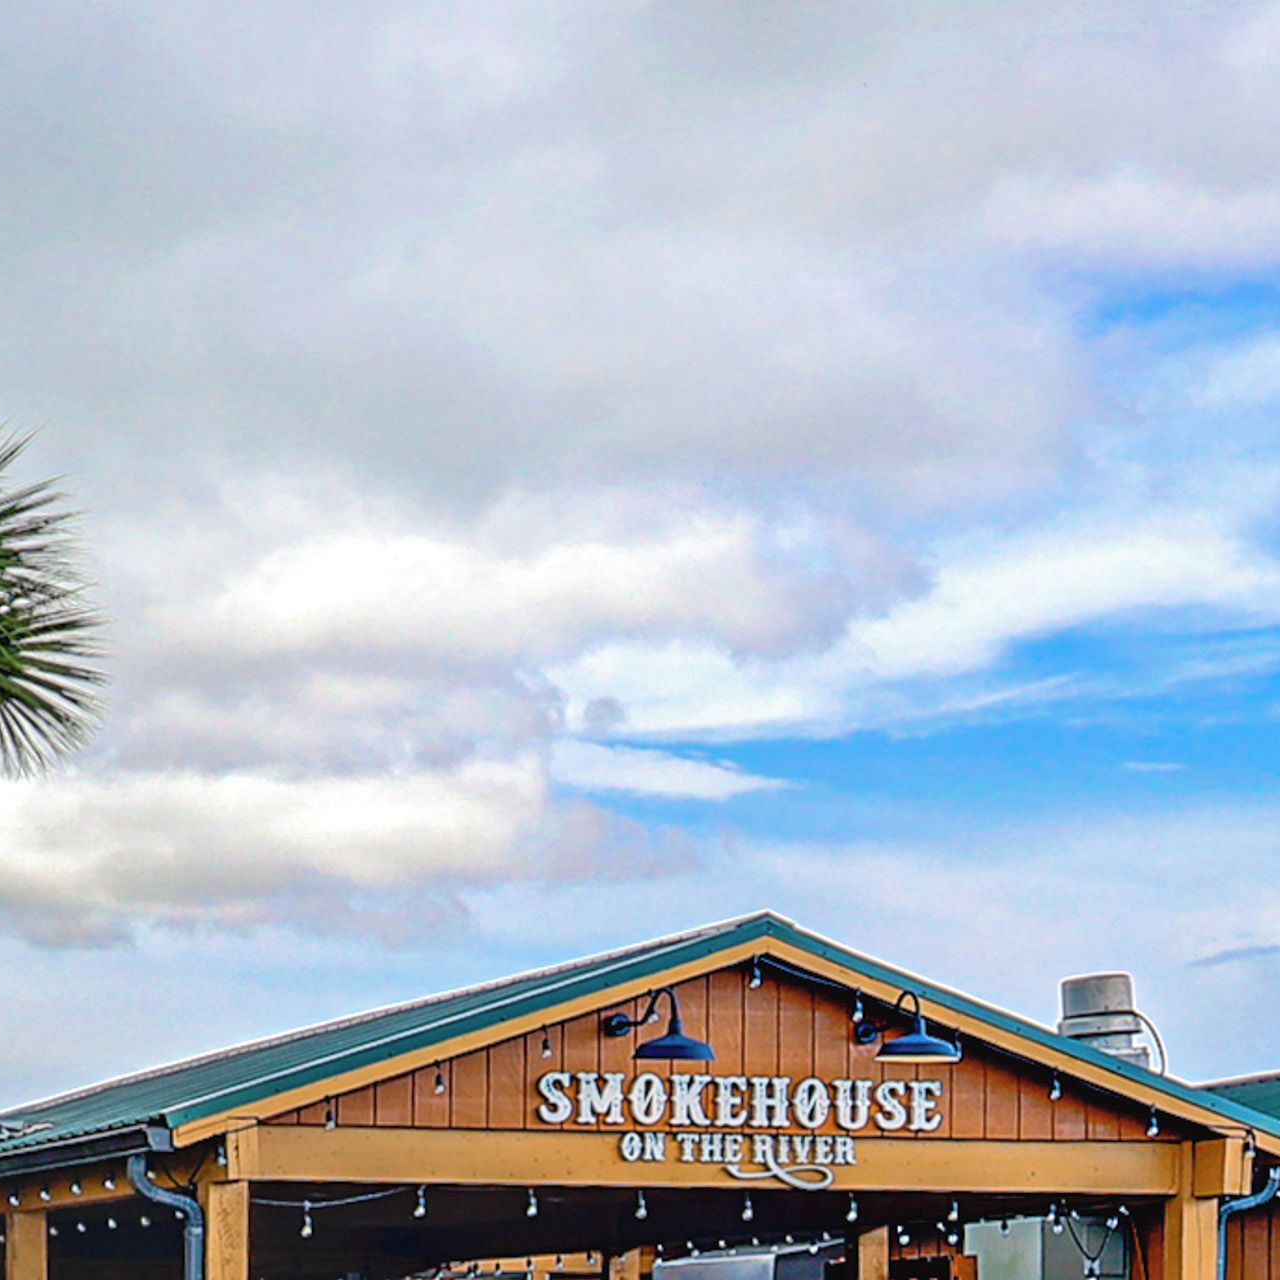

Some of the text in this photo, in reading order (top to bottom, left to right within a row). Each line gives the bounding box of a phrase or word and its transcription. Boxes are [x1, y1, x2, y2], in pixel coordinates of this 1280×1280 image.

[538, 1072, 942, 1131] SMOKEHOUSE
[620, 1132, 665, 1161] ON
[677, 1133, 742, 1163] THE
